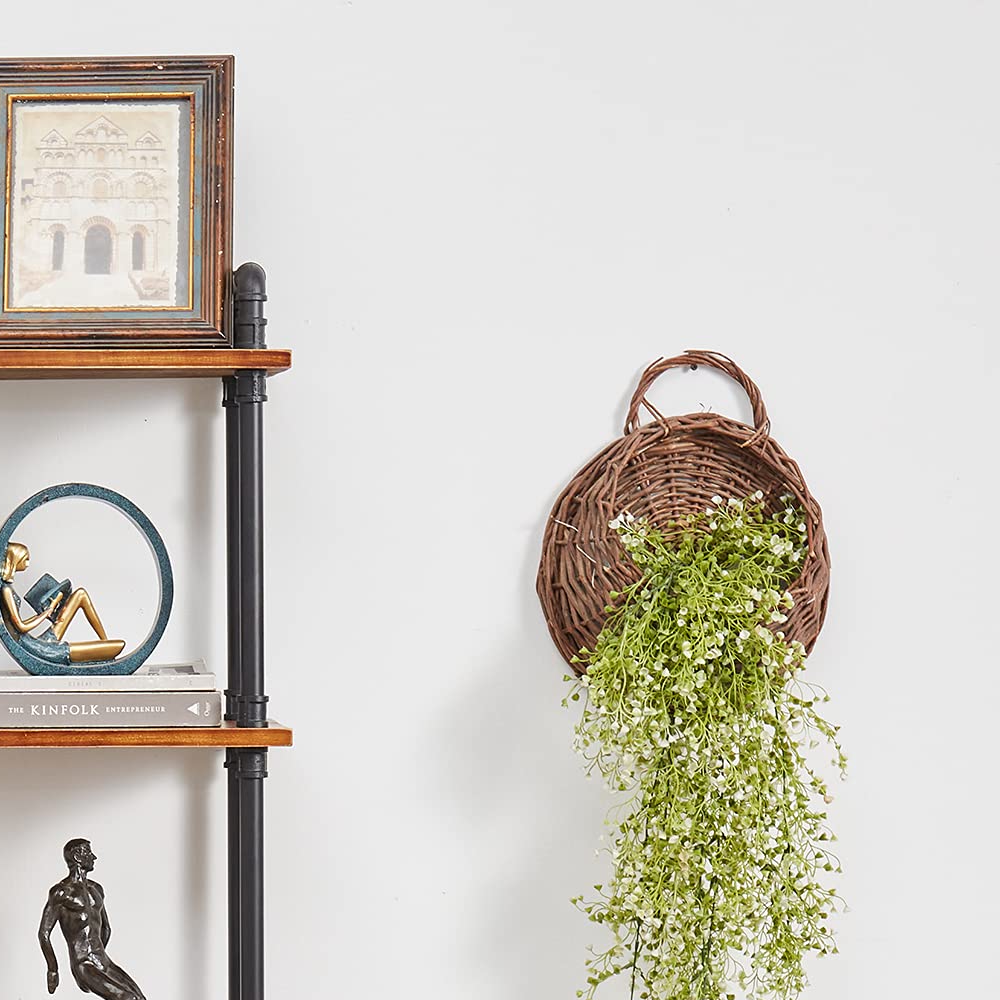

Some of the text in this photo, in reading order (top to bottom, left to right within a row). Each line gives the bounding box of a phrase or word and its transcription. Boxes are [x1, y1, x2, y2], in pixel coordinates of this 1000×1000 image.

[8, 704, 167, 716] THE KINFOLK ENTREPRENEUR
